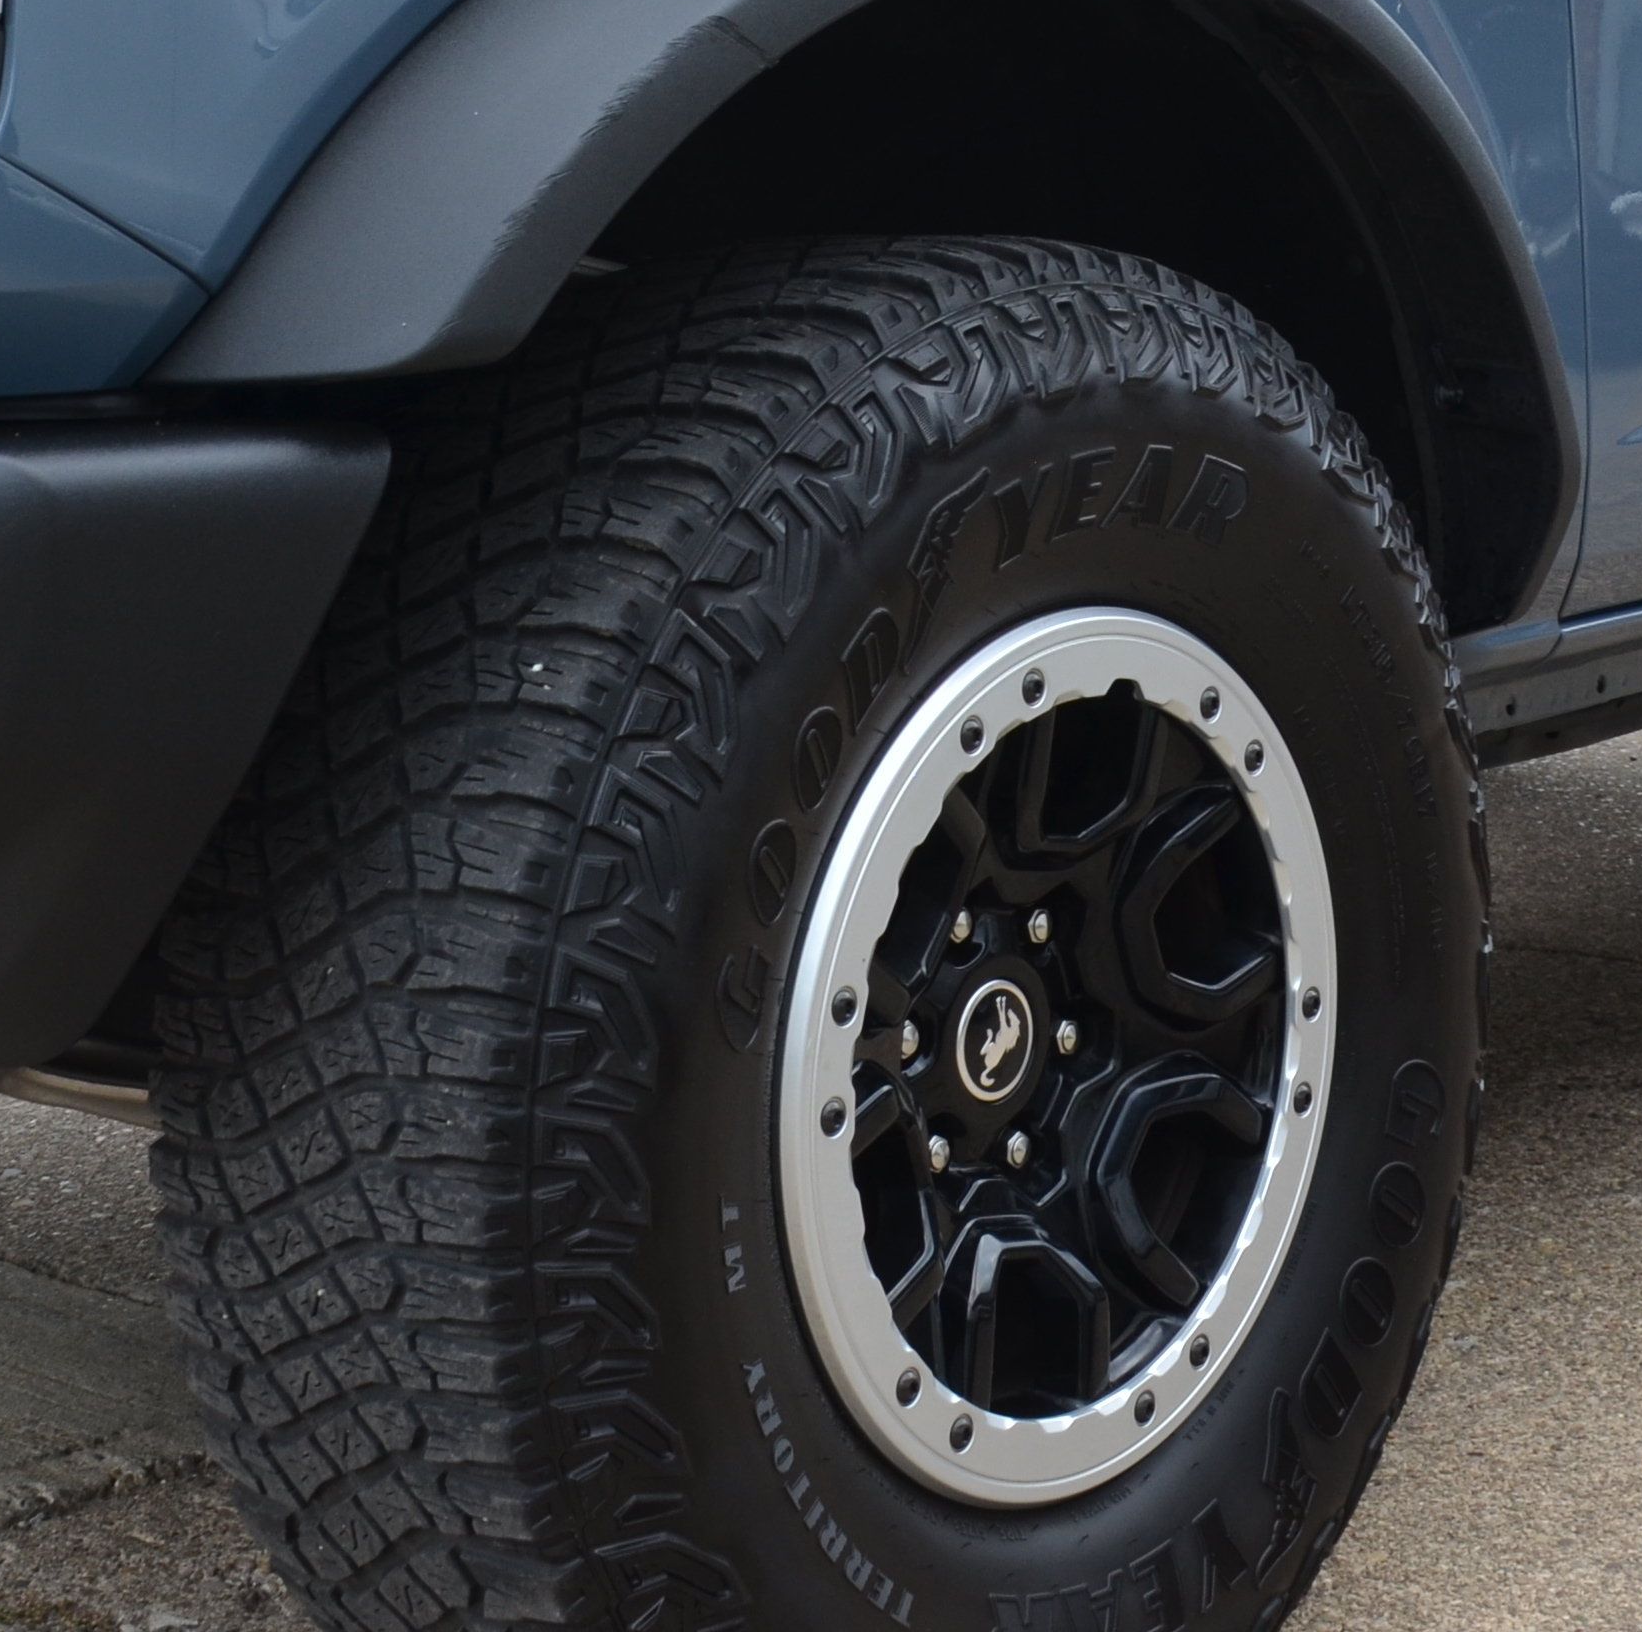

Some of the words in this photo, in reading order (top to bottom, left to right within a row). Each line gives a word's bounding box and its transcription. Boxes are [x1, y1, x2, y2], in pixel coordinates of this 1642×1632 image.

[714, 443, 1250, 1052] GOODYEAR
[719, 1191, 748, 1296] MT
[740, 1355, 917, 1630] TERRITORY
